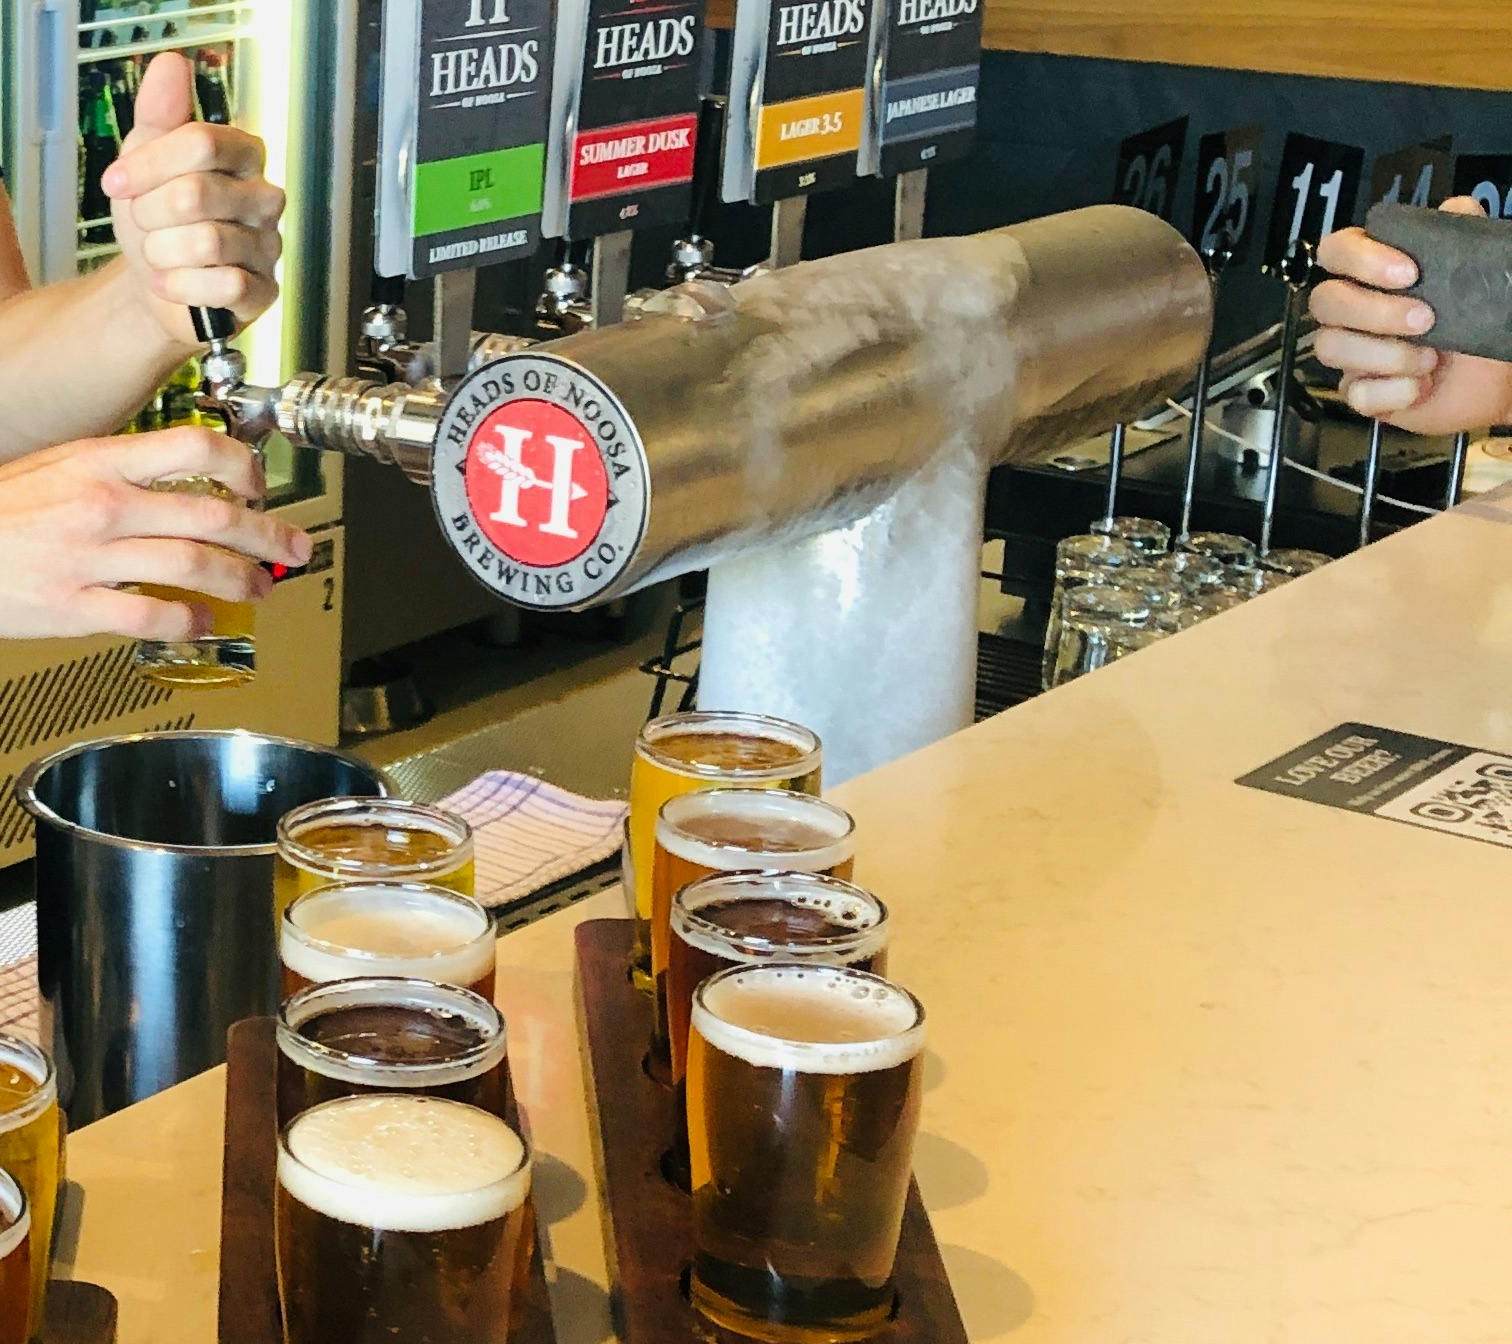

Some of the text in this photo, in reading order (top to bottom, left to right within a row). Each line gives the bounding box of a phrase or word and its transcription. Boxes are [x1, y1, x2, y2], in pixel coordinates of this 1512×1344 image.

[430, 40, 539, 98] HEADS
[593, 14, 696, 69] HEADS
[940, 85, 976, 106] LAGER
[579, 127, 691, 166] SUMMER DUSK
[780, 121, 820, 141] LAGER
[1201, 149, 1252, 254] 25
[1287, 161, 1343, 259] 11
[429, 229, 529, 264] LIMITED RELEASE
[447, 369, 632, 481] HEADS OF NOOSA
[451, 511, 624, 595] BREWING CO.
[1273, 753, 1337, 786] LOVE
[1324, 735, 1380, 763] OUR
